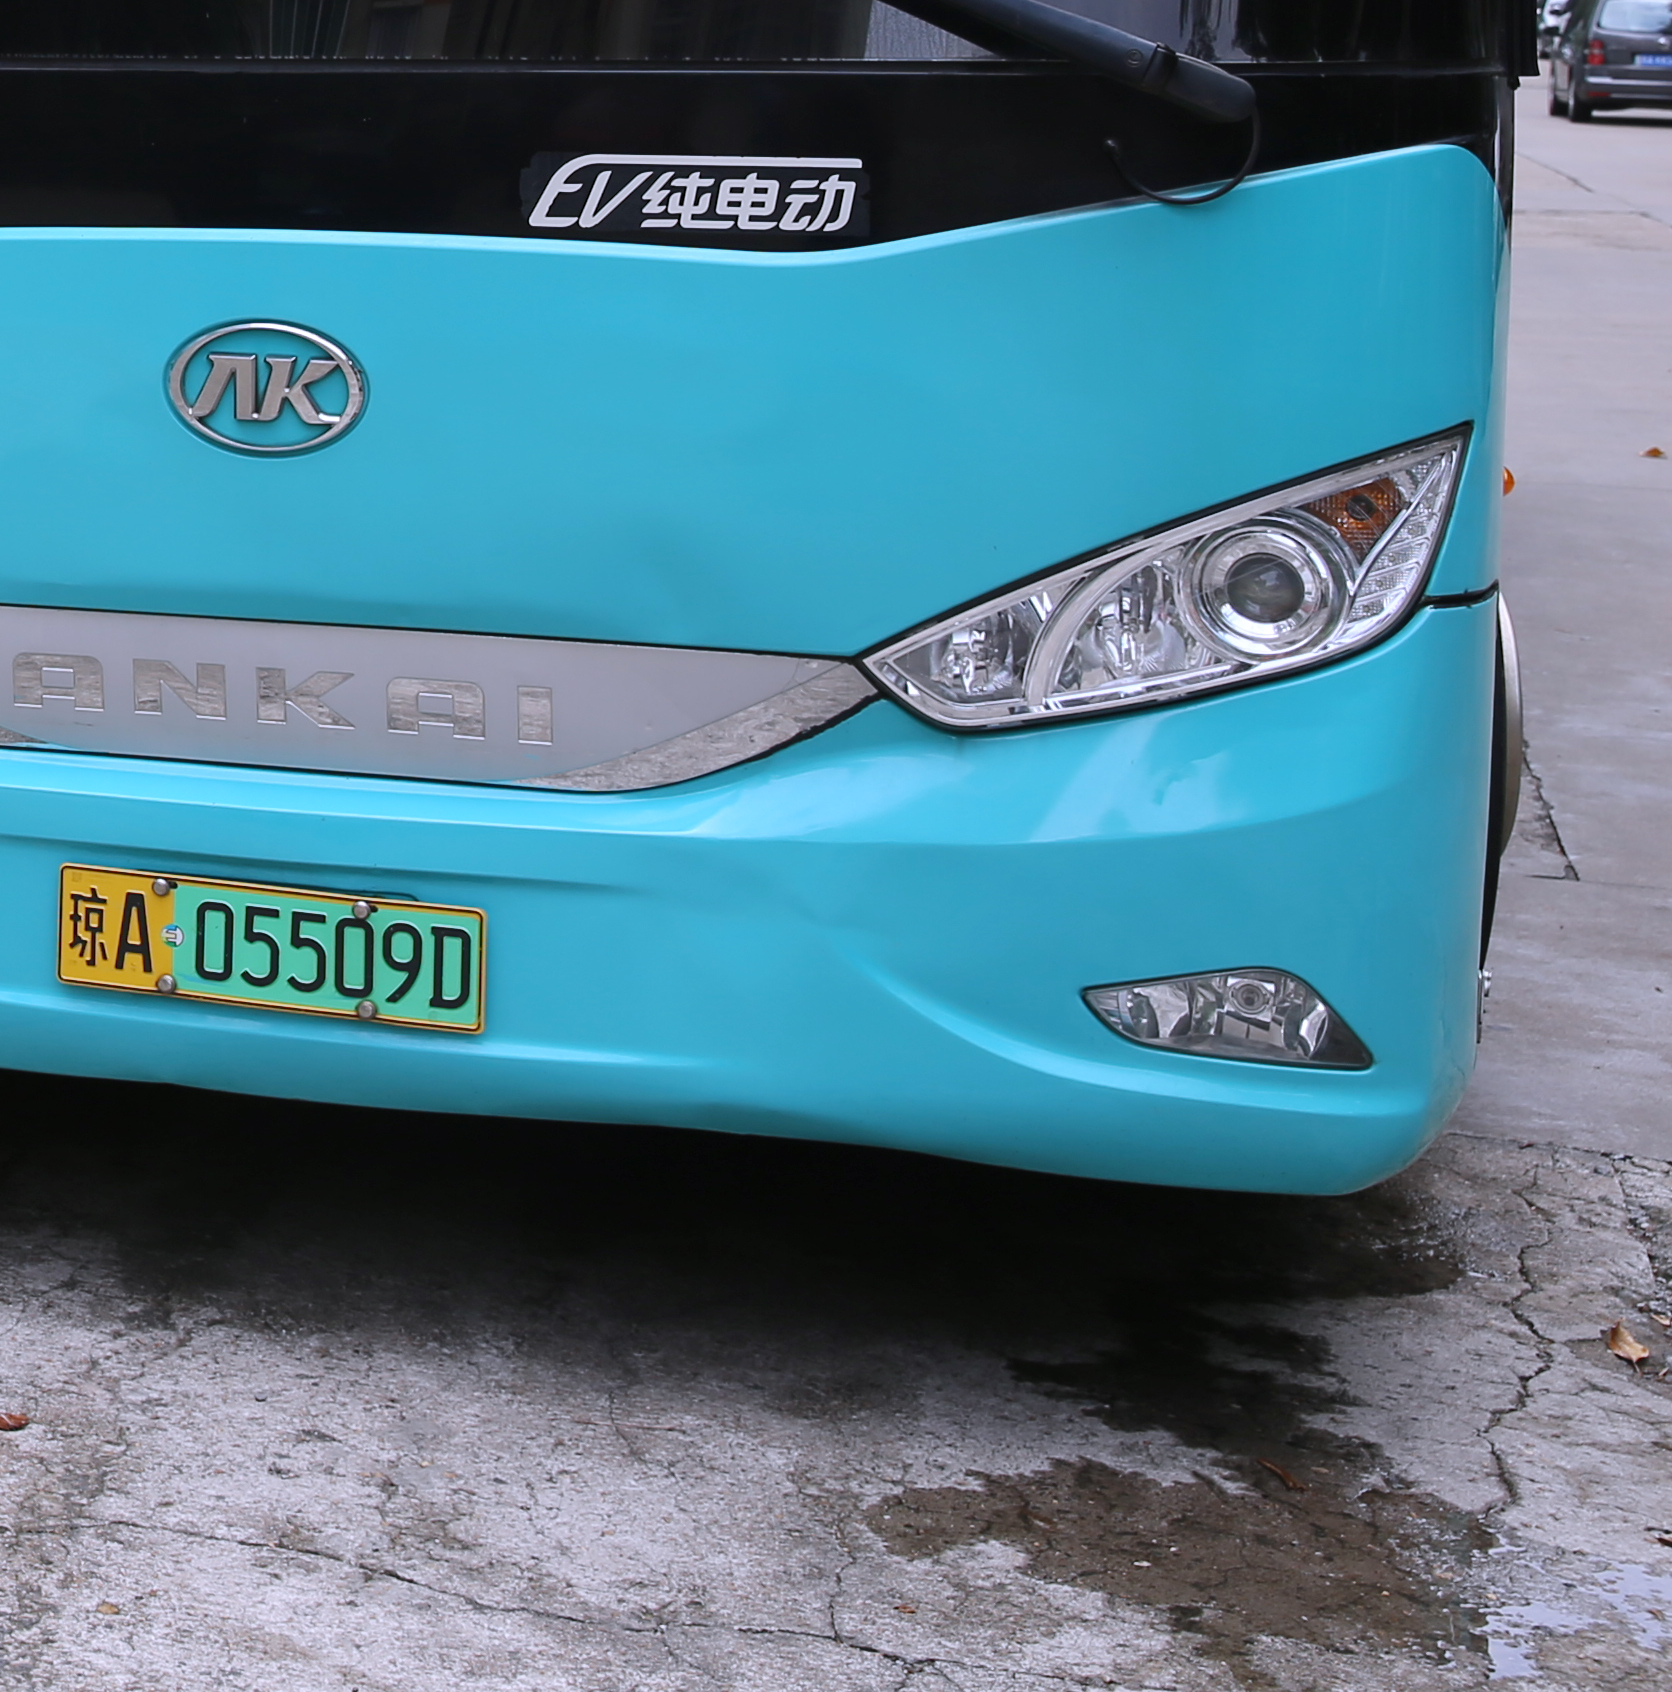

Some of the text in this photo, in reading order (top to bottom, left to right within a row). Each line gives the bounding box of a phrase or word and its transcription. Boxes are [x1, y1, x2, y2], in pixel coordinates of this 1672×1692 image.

[529, 154, 857, 232] EV 纯电动
[12, 651, 554, 745] ANKAI
[68, 886, 472, 1010] 琼A 05509D
